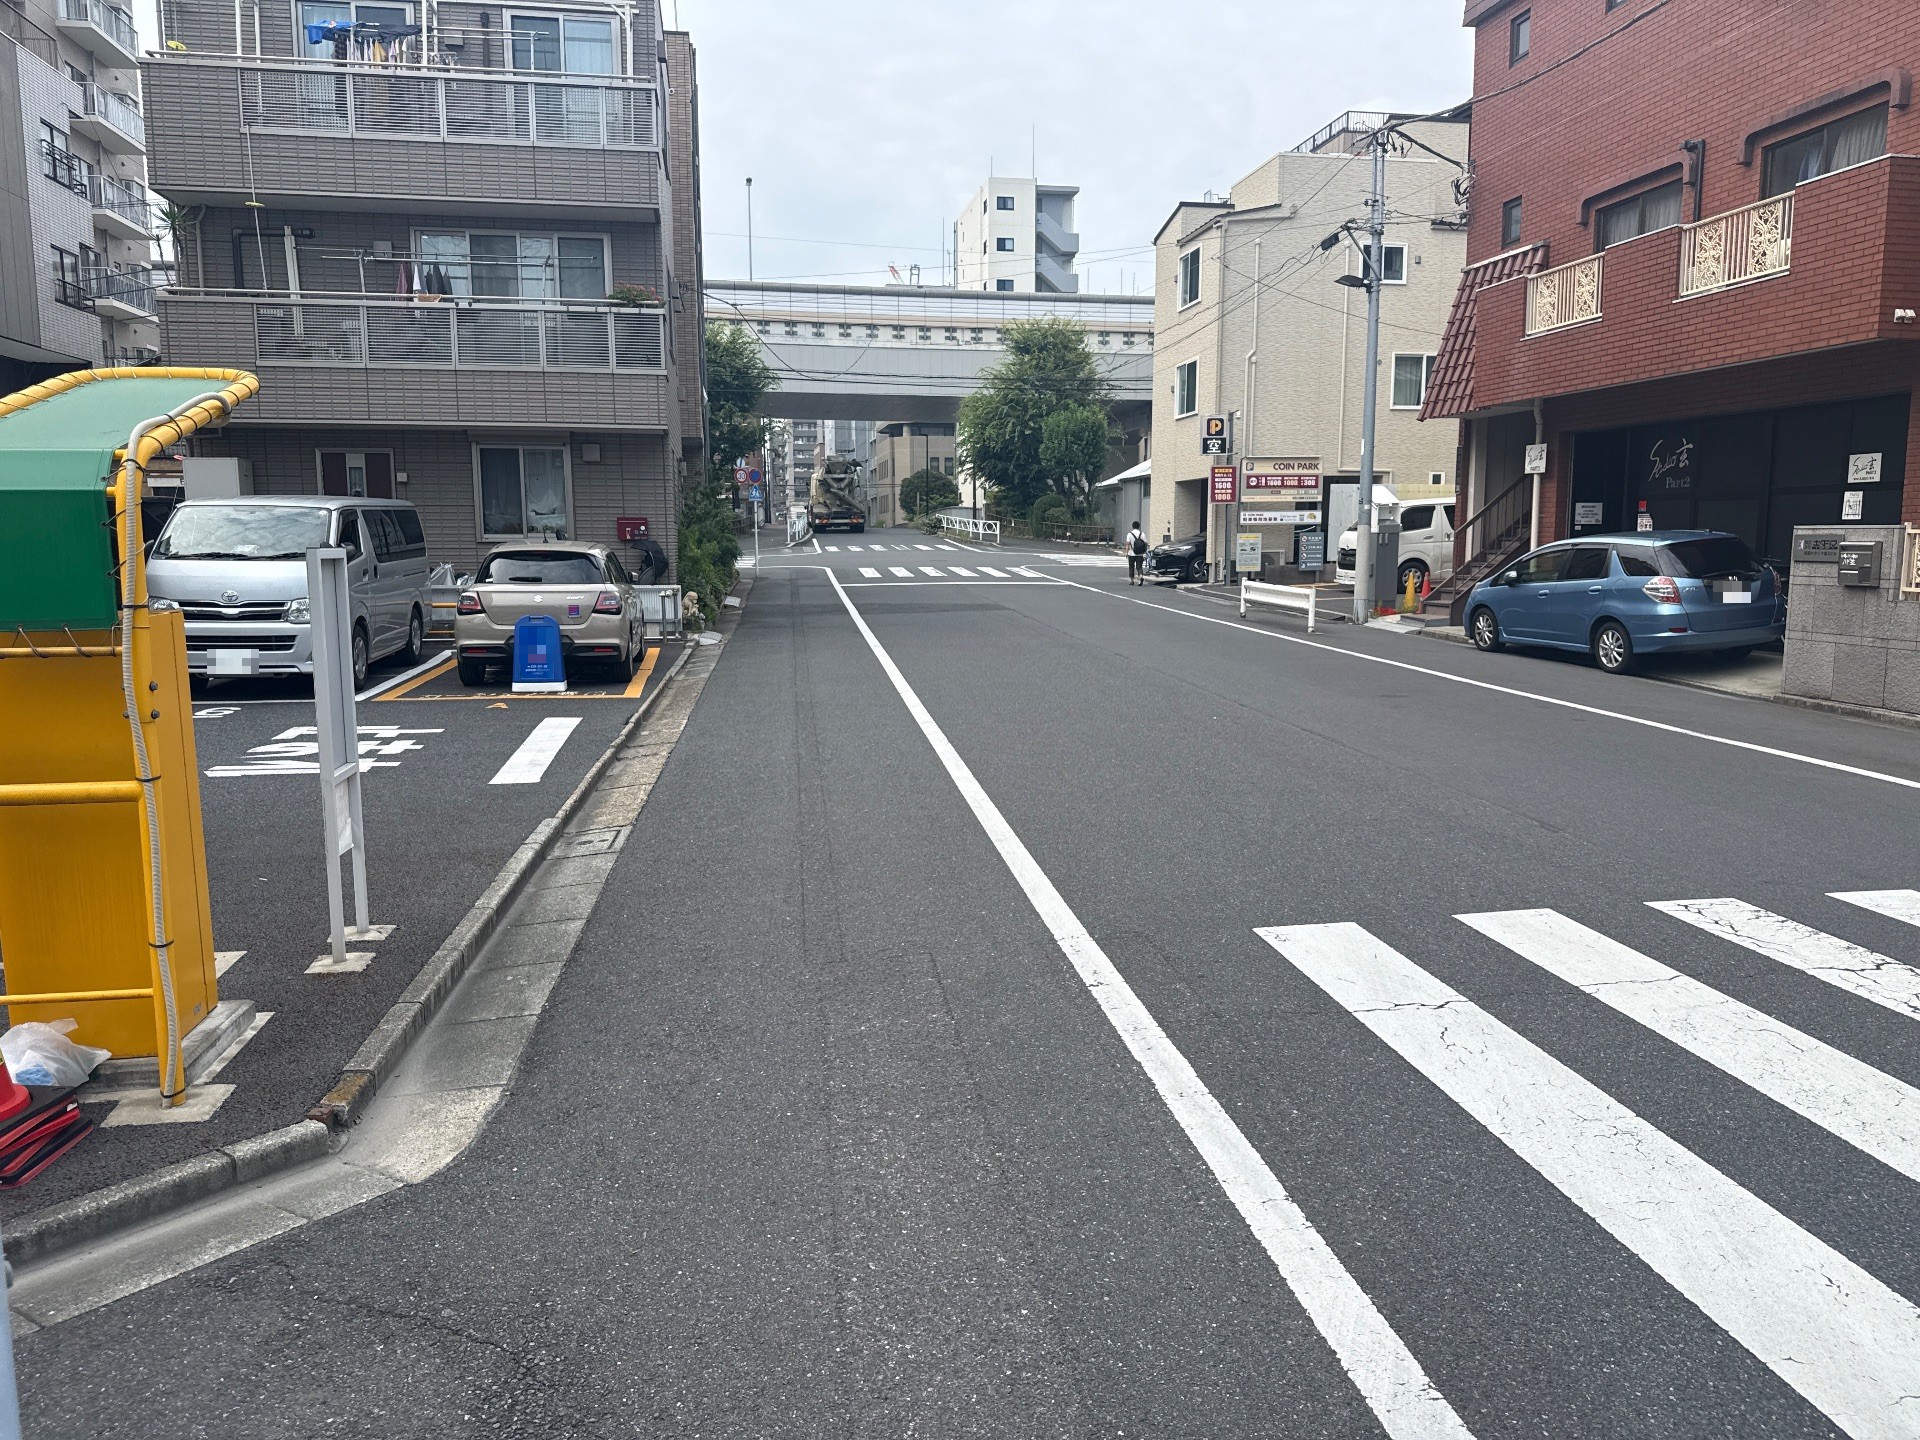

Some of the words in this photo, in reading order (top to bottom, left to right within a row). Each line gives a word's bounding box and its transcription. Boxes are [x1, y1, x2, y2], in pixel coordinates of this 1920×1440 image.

[1207, 439, 1221, 453] 空
[1273, 462, 1295, 471] COIN
[1297, 462, 1320, 471] PARK
[1666, 477, 1690, 489] Part2
